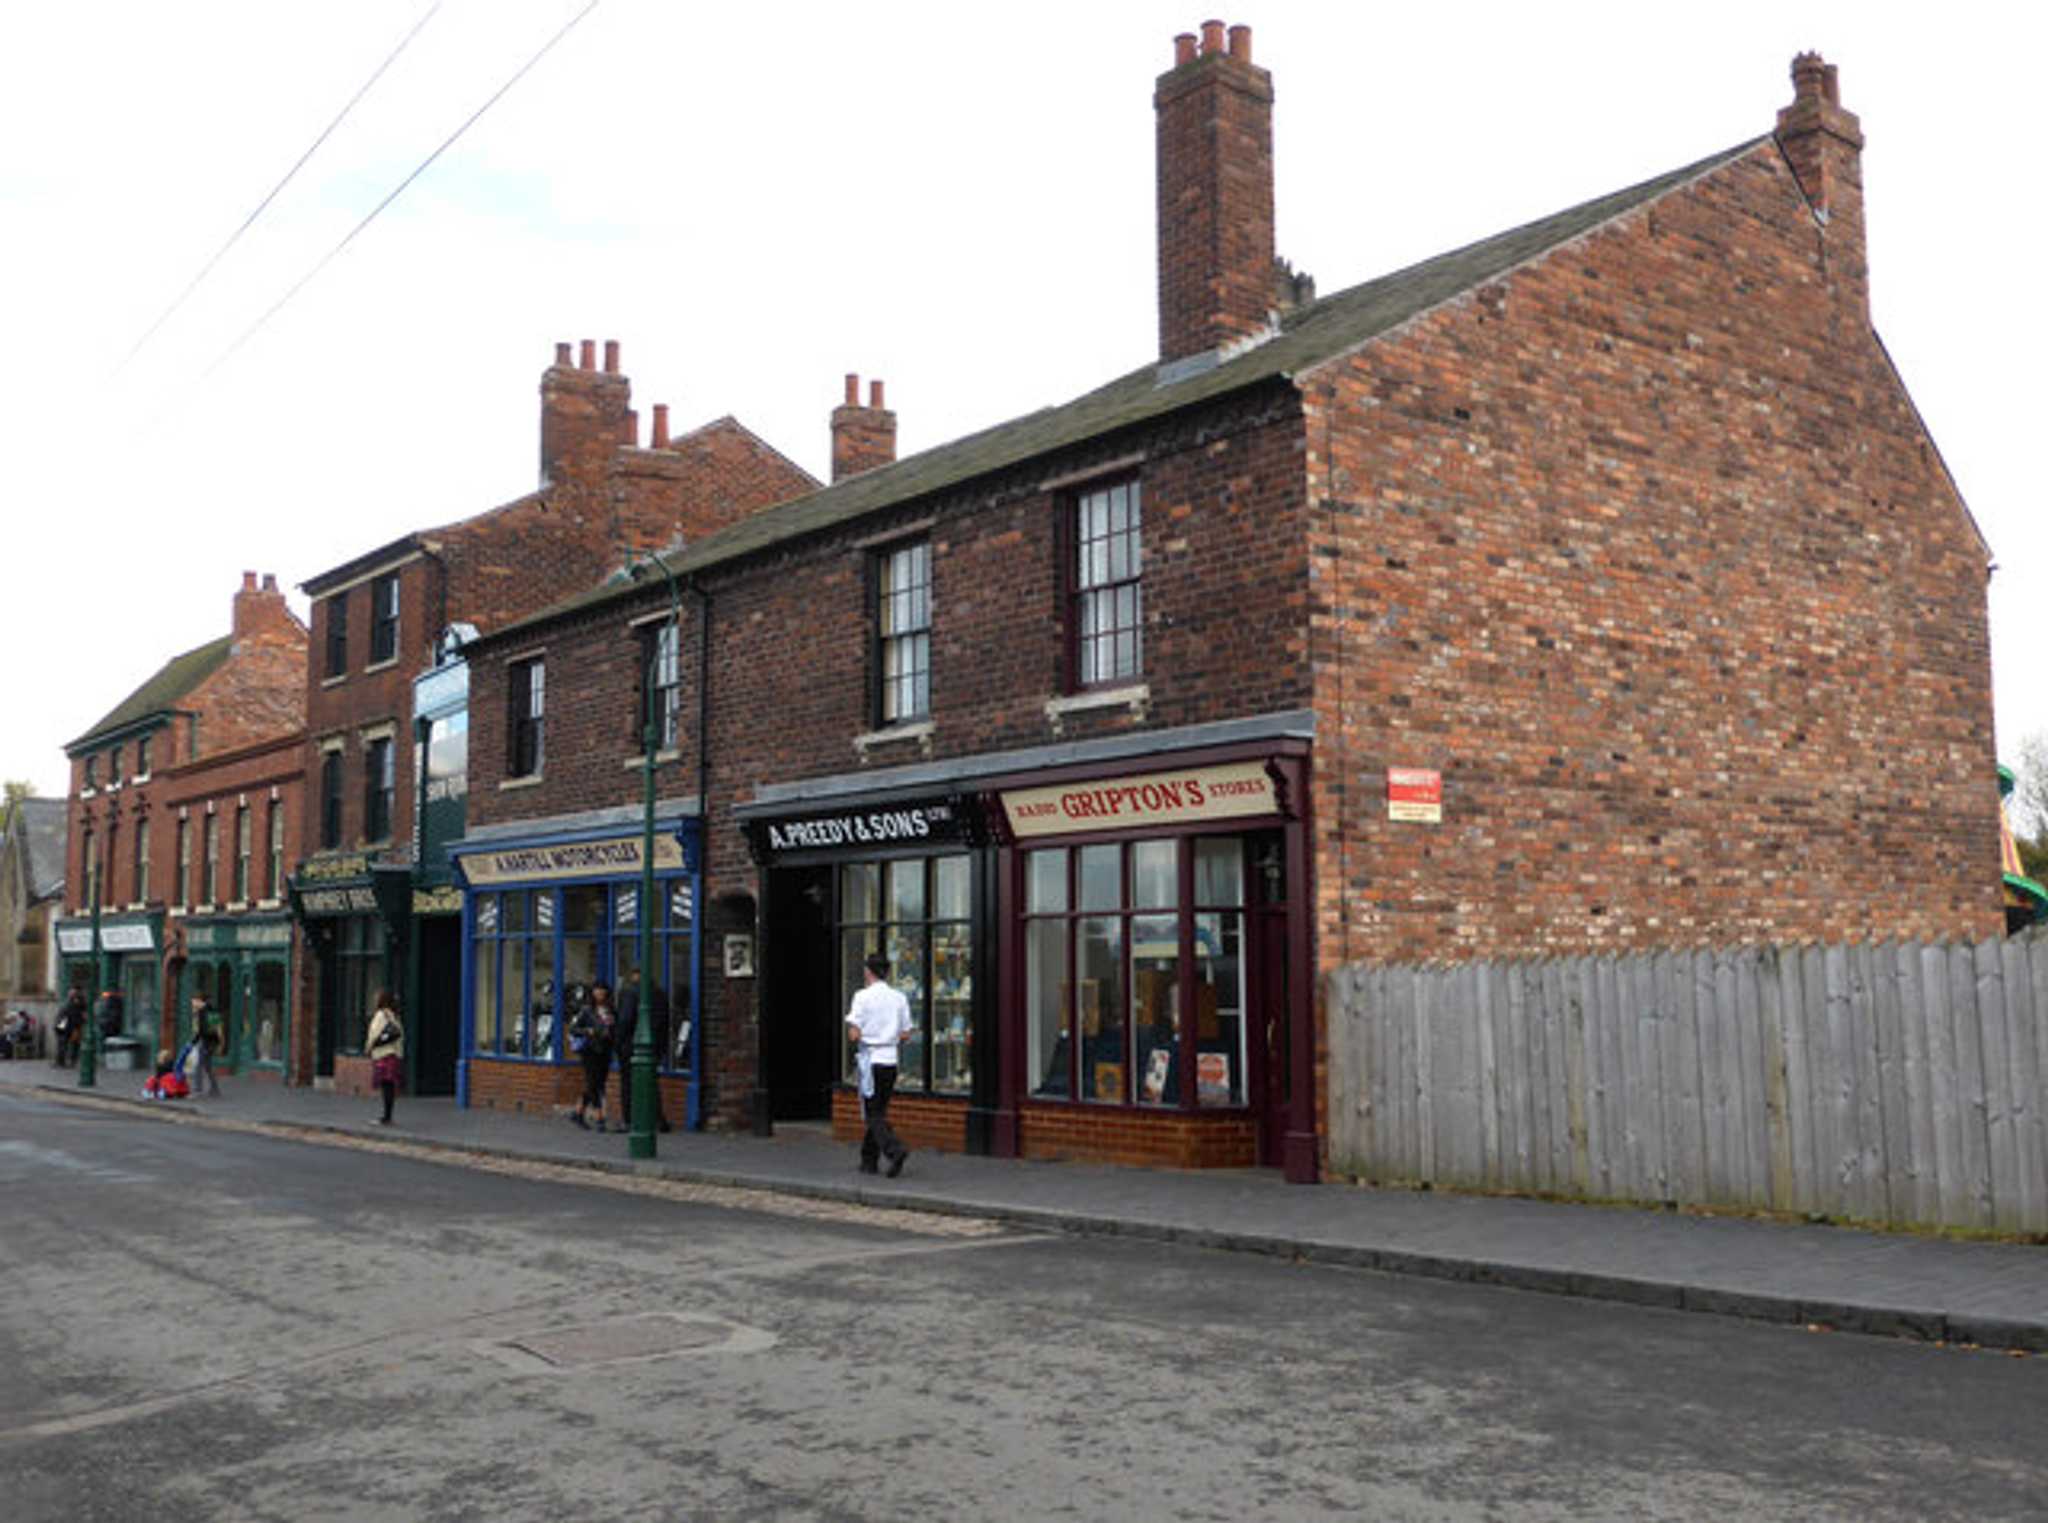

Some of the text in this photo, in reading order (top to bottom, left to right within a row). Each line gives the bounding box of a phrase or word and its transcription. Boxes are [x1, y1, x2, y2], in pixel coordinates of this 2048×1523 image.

[1062, 780, 1205, 818] GRIPTON'S
[1207, 779, 1266, 797] STORES
[869, 809, 929, 840] SONS
